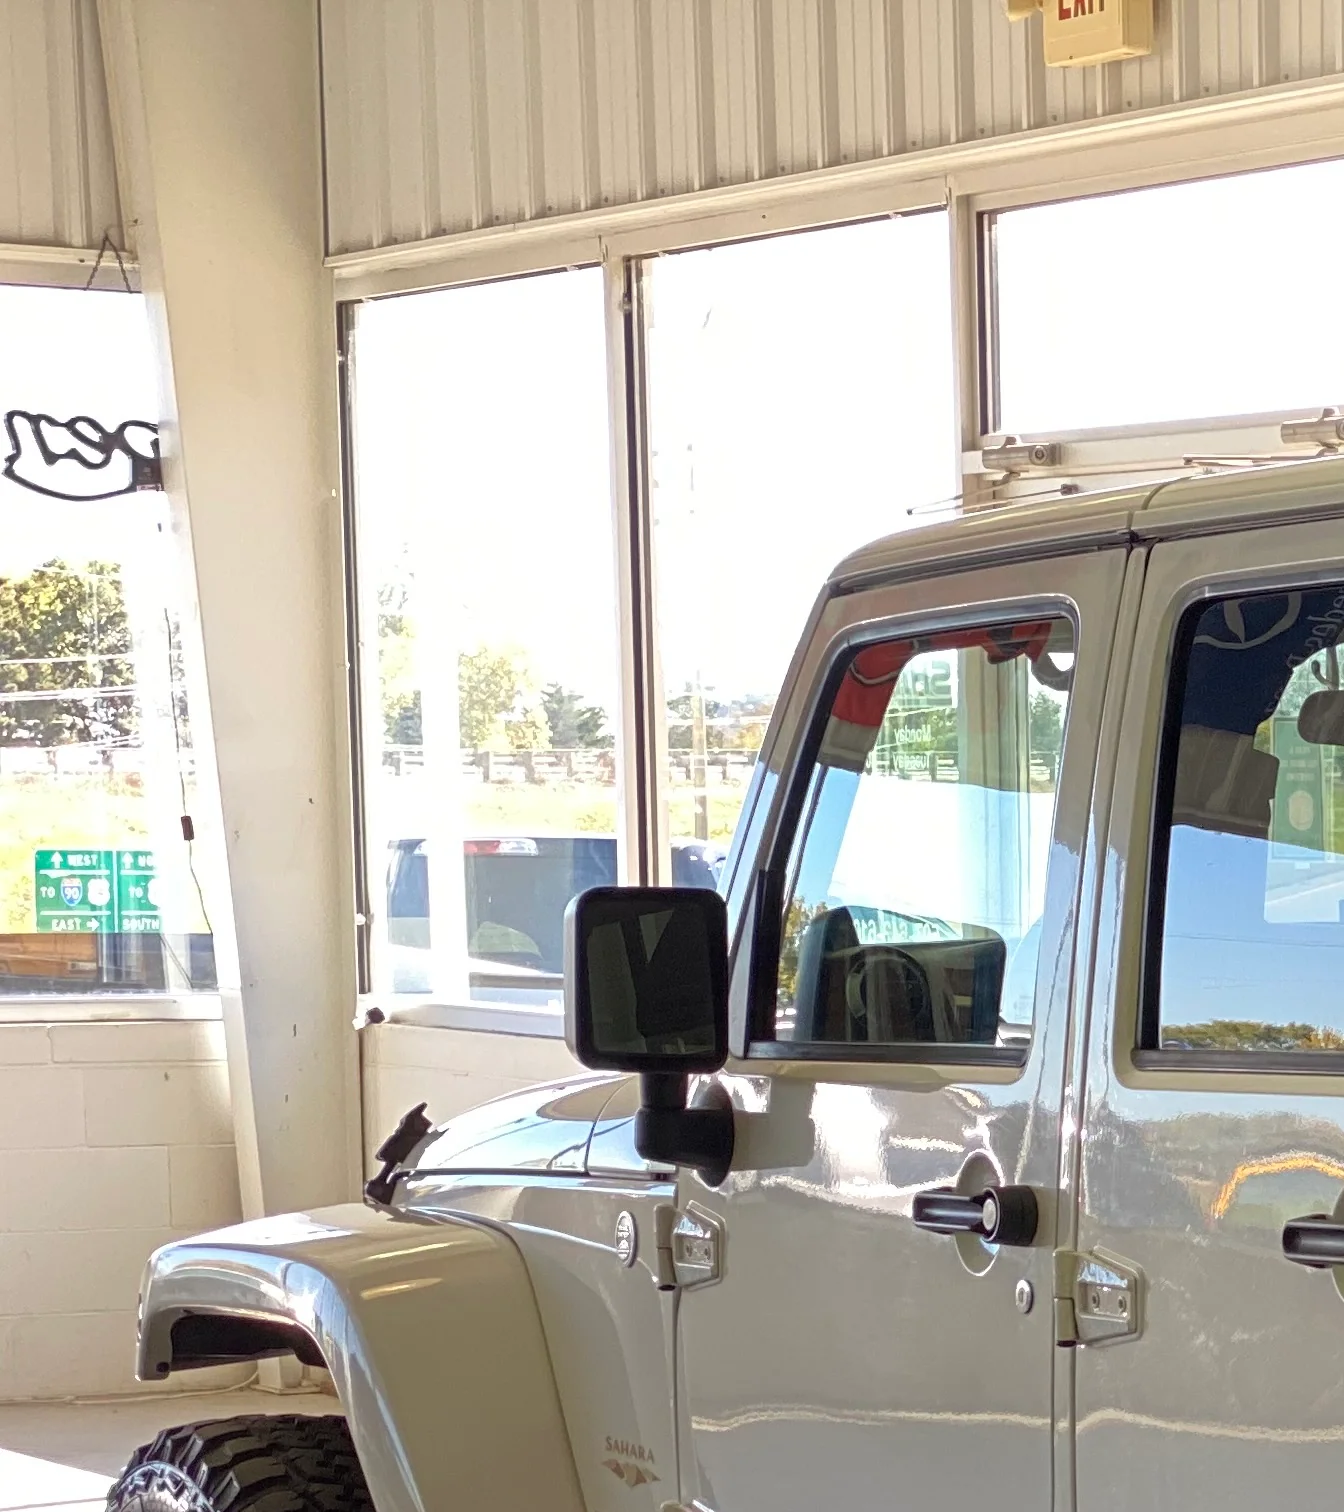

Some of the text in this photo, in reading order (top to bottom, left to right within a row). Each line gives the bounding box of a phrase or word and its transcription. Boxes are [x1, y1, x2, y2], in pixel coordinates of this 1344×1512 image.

[40, 886, 56, 898] TO
[64, 887, 80, 900] 90
[51, 918, 81, 931] EAST
[122, 918, 160, 931] SOUTH
[605, 1435, 655, 1464] SAHARA
